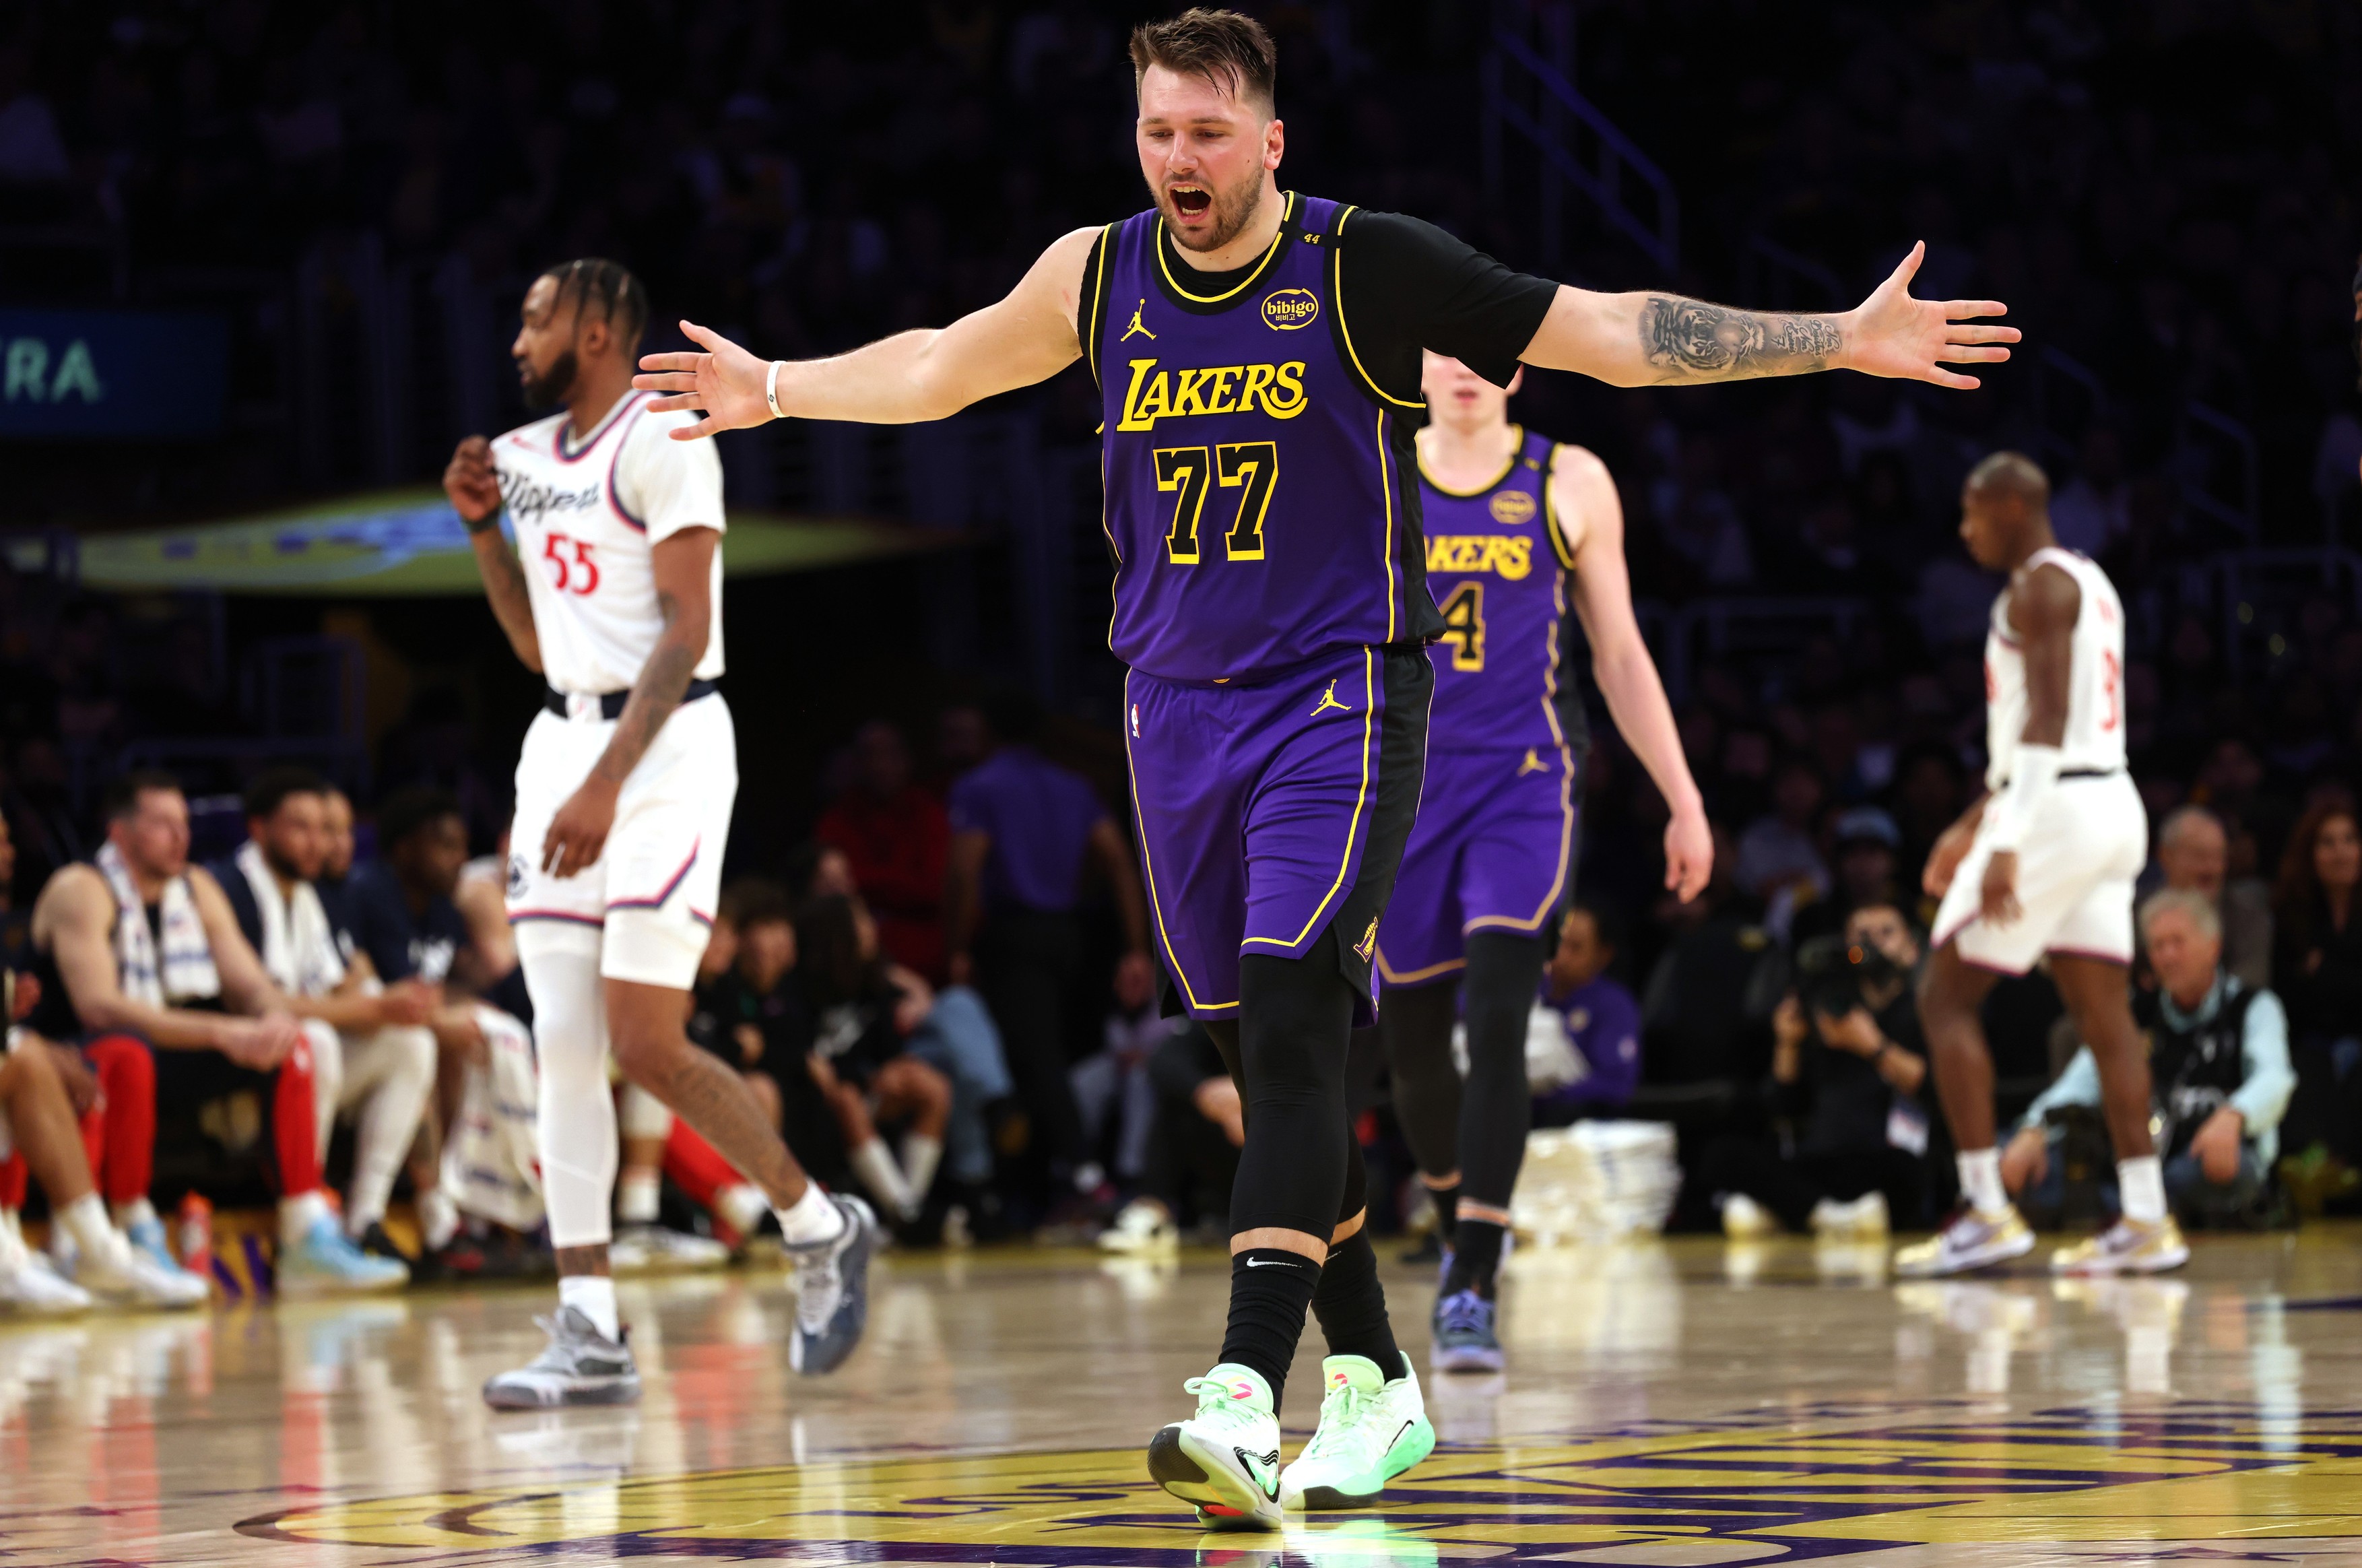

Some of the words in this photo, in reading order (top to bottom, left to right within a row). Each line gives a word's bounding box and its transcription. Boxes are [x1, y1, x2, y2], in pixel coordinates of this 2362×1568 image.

[1304, 234, 1320, 244] 44
[1267, 299, 1315, 317] bibigo
[1799, 327, 1814, 353] Non
[1825, 325, 1840, 350] Non
[0, 337, 105, 404] RA
[1116, 358, 1309, 432] LAKERS
[1152, 441, 1279, 565] 77
[544, 533, 600, 597] 55
[1424, 535, 1534, 581] KERS
[1439, 580, 1486, 672] 4
